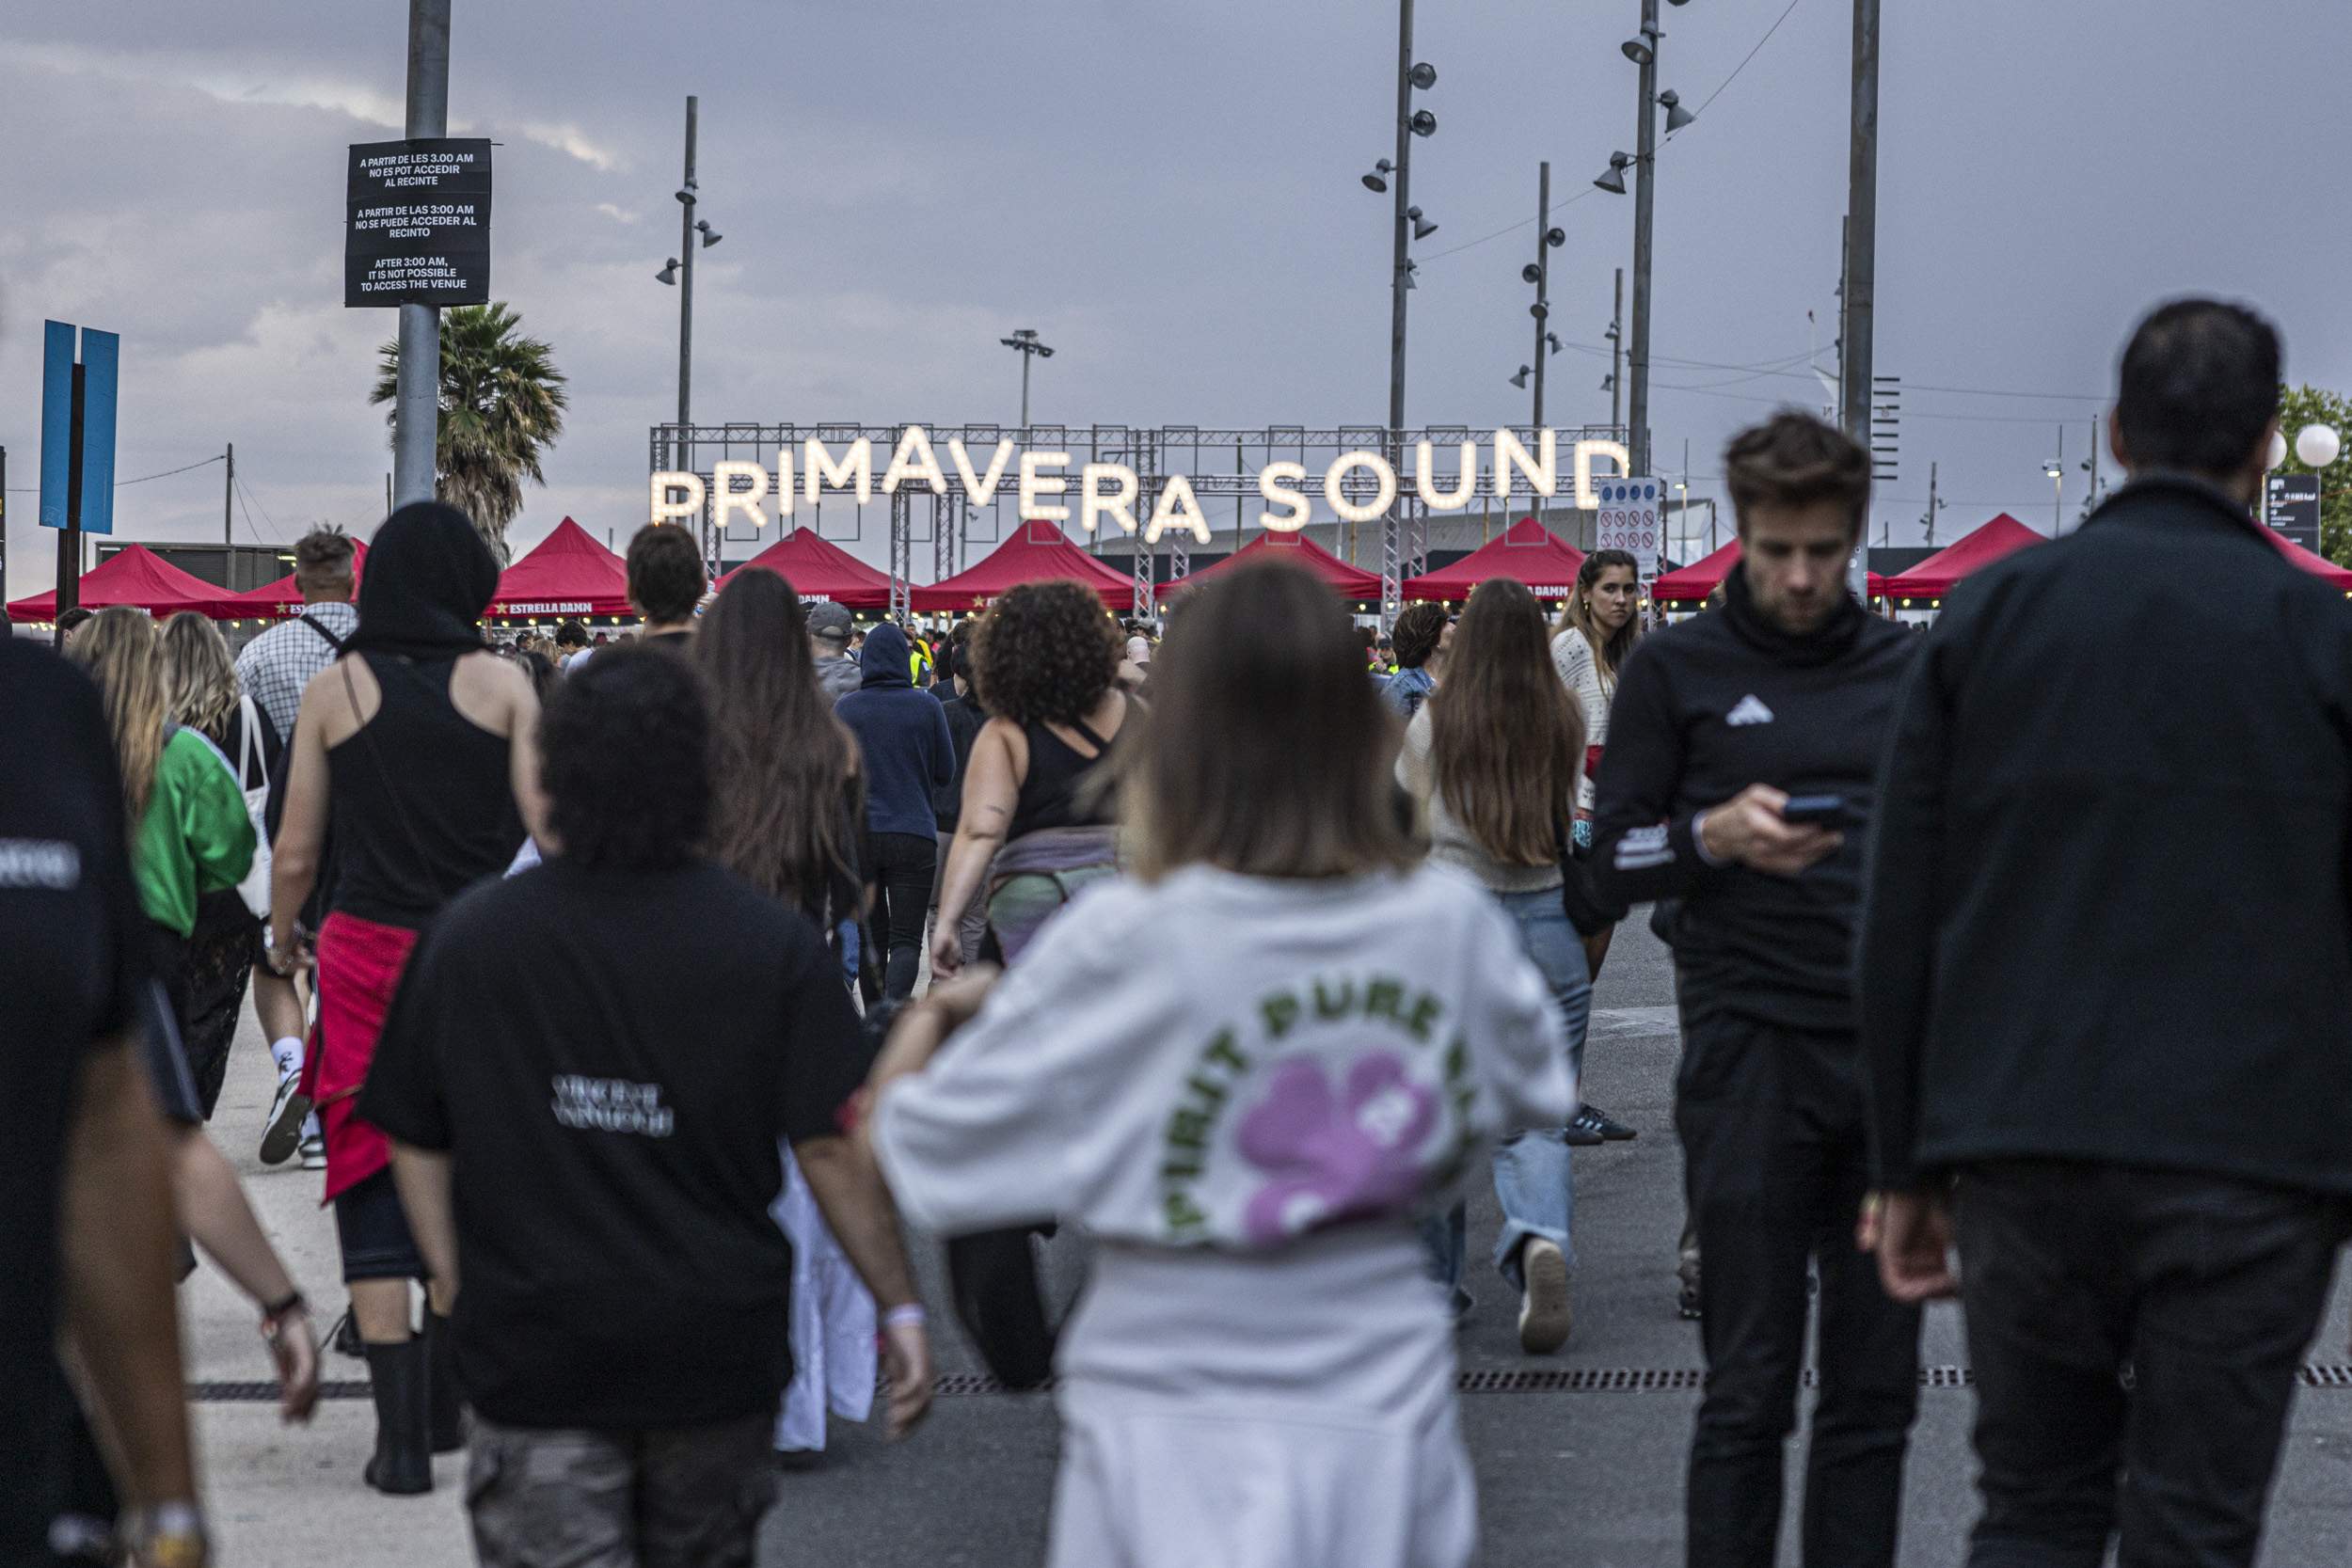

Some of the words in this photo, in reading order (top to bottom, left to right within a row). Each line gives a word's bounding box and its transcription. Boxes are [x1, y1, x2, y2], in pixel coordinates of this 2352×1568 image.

[360, 159, 366, 167] A
[369, 156, 396, 166] PARTIR
[398, 155, 408, 164] DE
[411, 154, 428, 163] LES
[431, 153, 453, 163] 3.00
[456, 153, 473, 162] AM
[369, 168, 381, 177] NO
[383, 167, 393, 176] ES
[395, 166, 411, 175] POT
[414, 165, 459, 174] ACCEDIR
[385, 179, 395, 187] AL
[397, 176, 438, 186] RECINTE
[358, 210, 363, 218] A
[365, 207, 392, 217] PARTIR
[395, 206, 407, 215] DE
[409, 206, 428, 214] LAS
[430, 205, 453, 214] 3:00
[456, 205, 473, 214] AM
[356, 220, 367, 230] NO
[369, 219, 378, 229] SE
[380, 217, 408, 227] PUEDE
[411, 216, 460, 226] ACCEDER
[462, 216, 477, 226] AL
[389, 228, 430, 238] RECINTO
[375, 259, 402, 268] AFTER
[404, 258, 425, 266] 3:00
[428, 257, 448, 267] AM,
[369, 271, 376, 280] IT
[378, 270, 386, 279] IS
[388, 269, 405, 278] NOT
[407, 268, 456, 277] POSSIBLE
[361, 282, 372, 292] TO
[373, 280, 406, 291] ACCESS
[408, 280, 428, 289] THE
[430, 279, 467, 289] VENUE
[650, 425, 1212, 545] PRIMAVERA
[1259, 428, 1630, 532] SOUND
[1534, 586, 1569, 596] DAMM
[509, 603, 559, 614] ESTRELLA
[560, 602, 593, 613] DAMM
